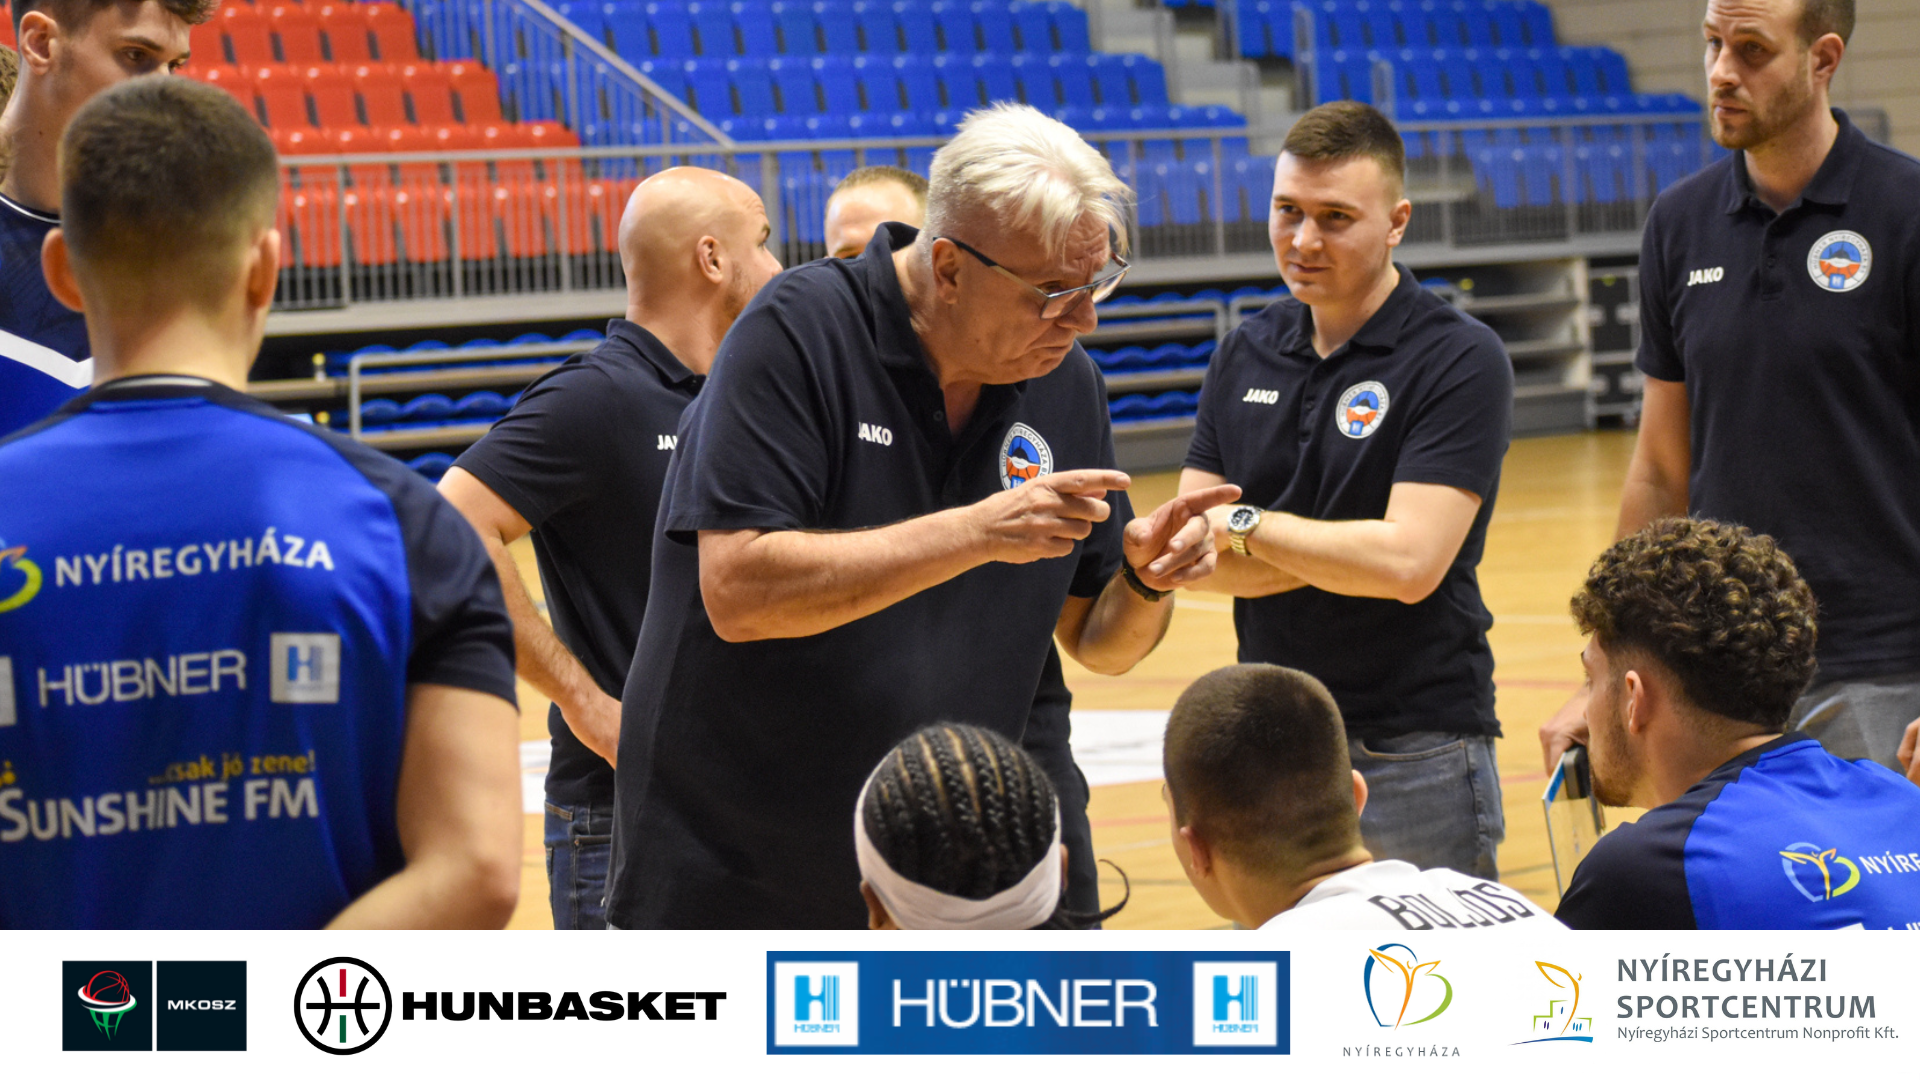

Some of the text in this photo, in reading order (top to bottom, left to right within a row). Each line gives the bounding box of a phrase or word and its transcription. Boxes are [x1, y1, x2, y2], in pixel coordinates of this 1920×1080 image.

[1687, 266, 1724, 286] JAKO
[1242, 388, 1280, 405] JAKO
[55, 526, 335, 588] NYÍREGYHÁZA
[37, 649, 248, 707] HÜBNER
[222, 752, 244, 783] jó
[251, 749, 316, 775] zene!
[0, 778, 319, 842] SUNSHINE FM
